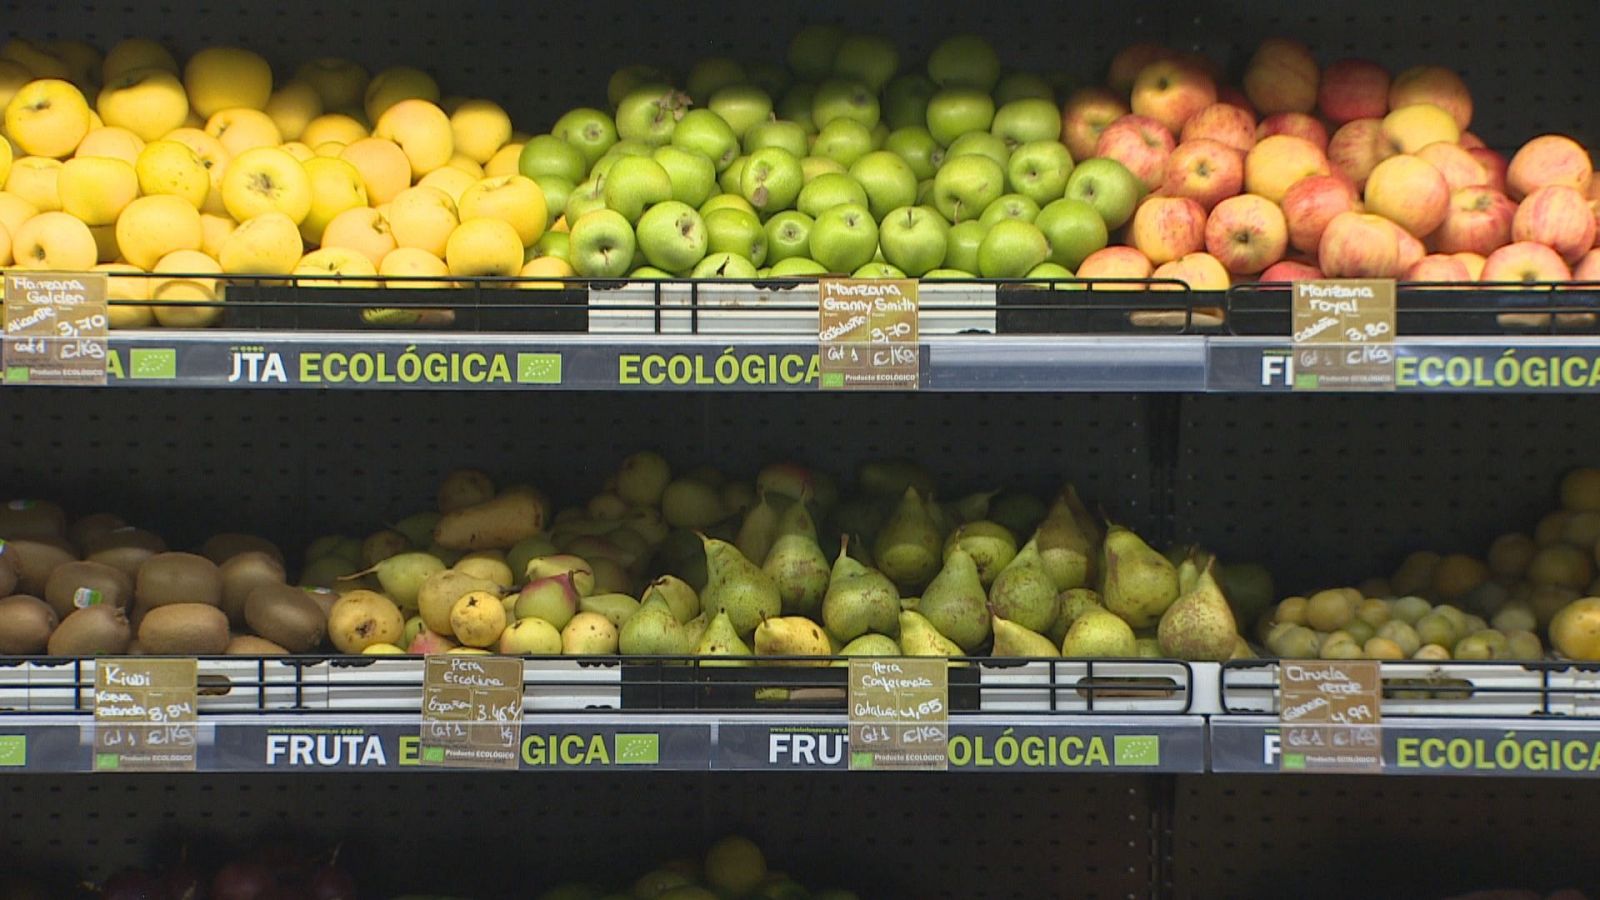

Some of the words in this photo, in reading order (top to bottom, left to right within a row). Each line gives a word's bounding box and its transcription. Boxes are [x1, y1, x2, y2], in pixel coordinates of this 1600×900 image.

[12, 276, 84, 290] Manzana
[825, 282, 901, 296] Manzana
[1299, 284, 1374, 298] Manzana
[26, 291, 85, 304] Golden
[824, 297, 873, 314] Granny
[875, 296, 915, 311] Smith
[57, 314, 105, 338] 3,70
[871, 322, 910, 344] 3,70
[1345, 321, 1390, 341] 3,80
[299, 345, 512, 383] ECOLÓGICA
[845, 373, 875, 381] Producto
[105, 665, 150, 686] Kiwi
[451, 658, 485, 674] Pera
[148, 702, 192, 723] 8,84
[900, 698, 943, 720] 4,65
[266, 733, 387, 766] FRUTA
[445, 749, 475, 758] Producto
